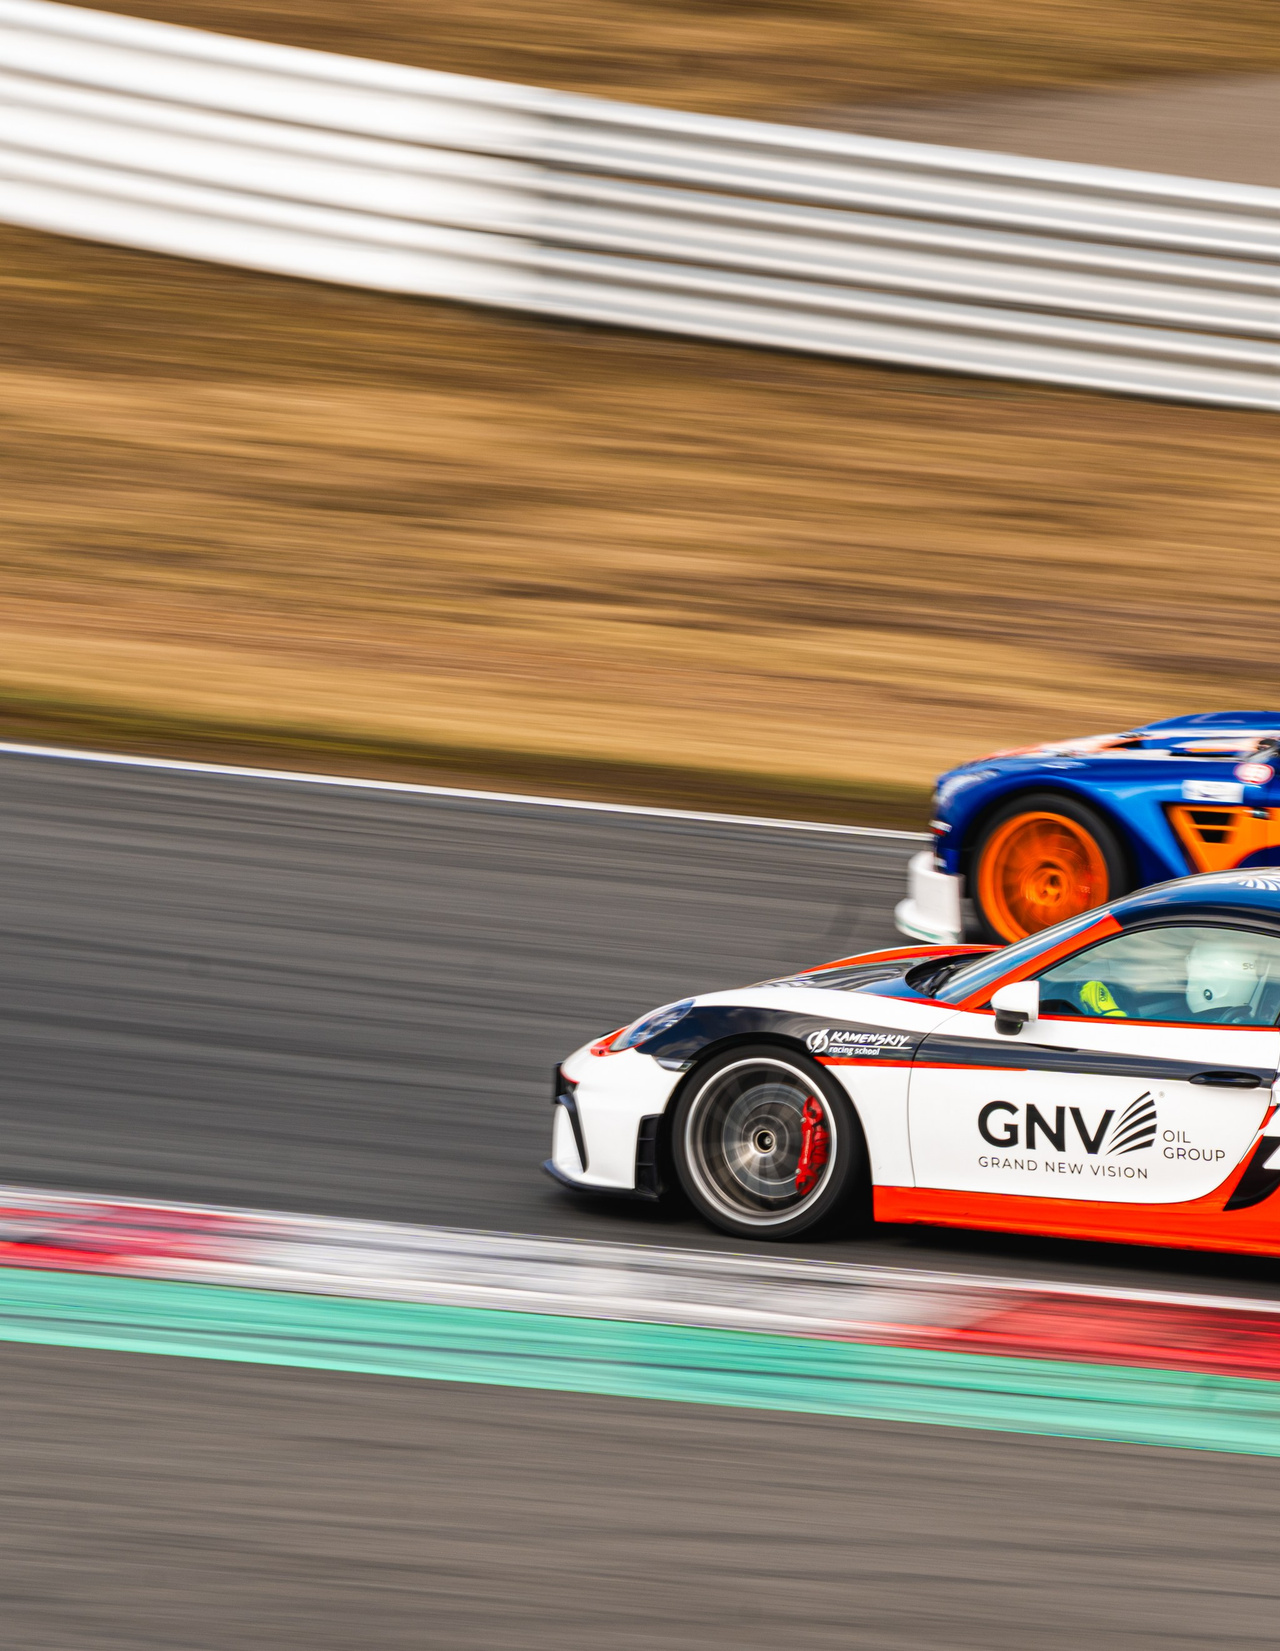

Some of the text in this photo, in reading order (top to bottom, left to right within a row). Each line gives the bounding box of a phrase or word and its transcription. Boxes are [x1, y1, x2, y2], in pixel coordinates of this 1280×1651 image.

[828, 1031, 910, 1048] KAMENSKIY
[828, 1046, 880, 1056] racing school
[977, 1100, 1115, 1155] GNV
[1163, 1129, 1191, 1144] OIL
[1163, 1146, 1226, 1162] GROUP
[978, 1156, 1148, 1179] GRAND NEW VISION
